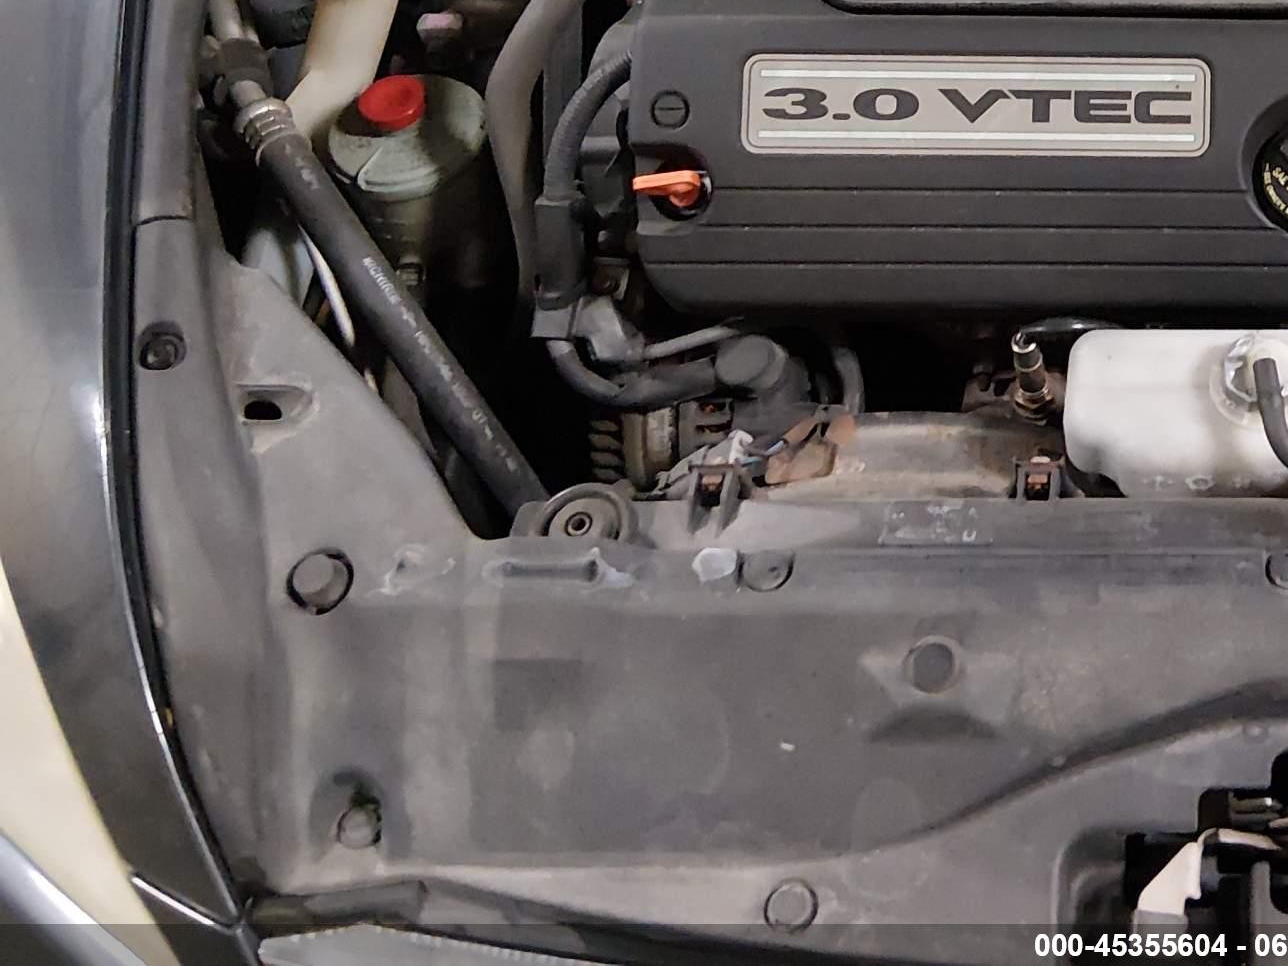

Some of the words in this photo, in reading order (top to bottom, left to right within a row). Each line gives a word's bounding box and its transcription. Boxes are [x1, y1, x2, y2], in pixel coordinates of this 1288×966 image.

[763, 87, 920, 121] 3.0
[938, 89, 1192, 124] VTEC
[1272, 167, 1288, 185] SAE
